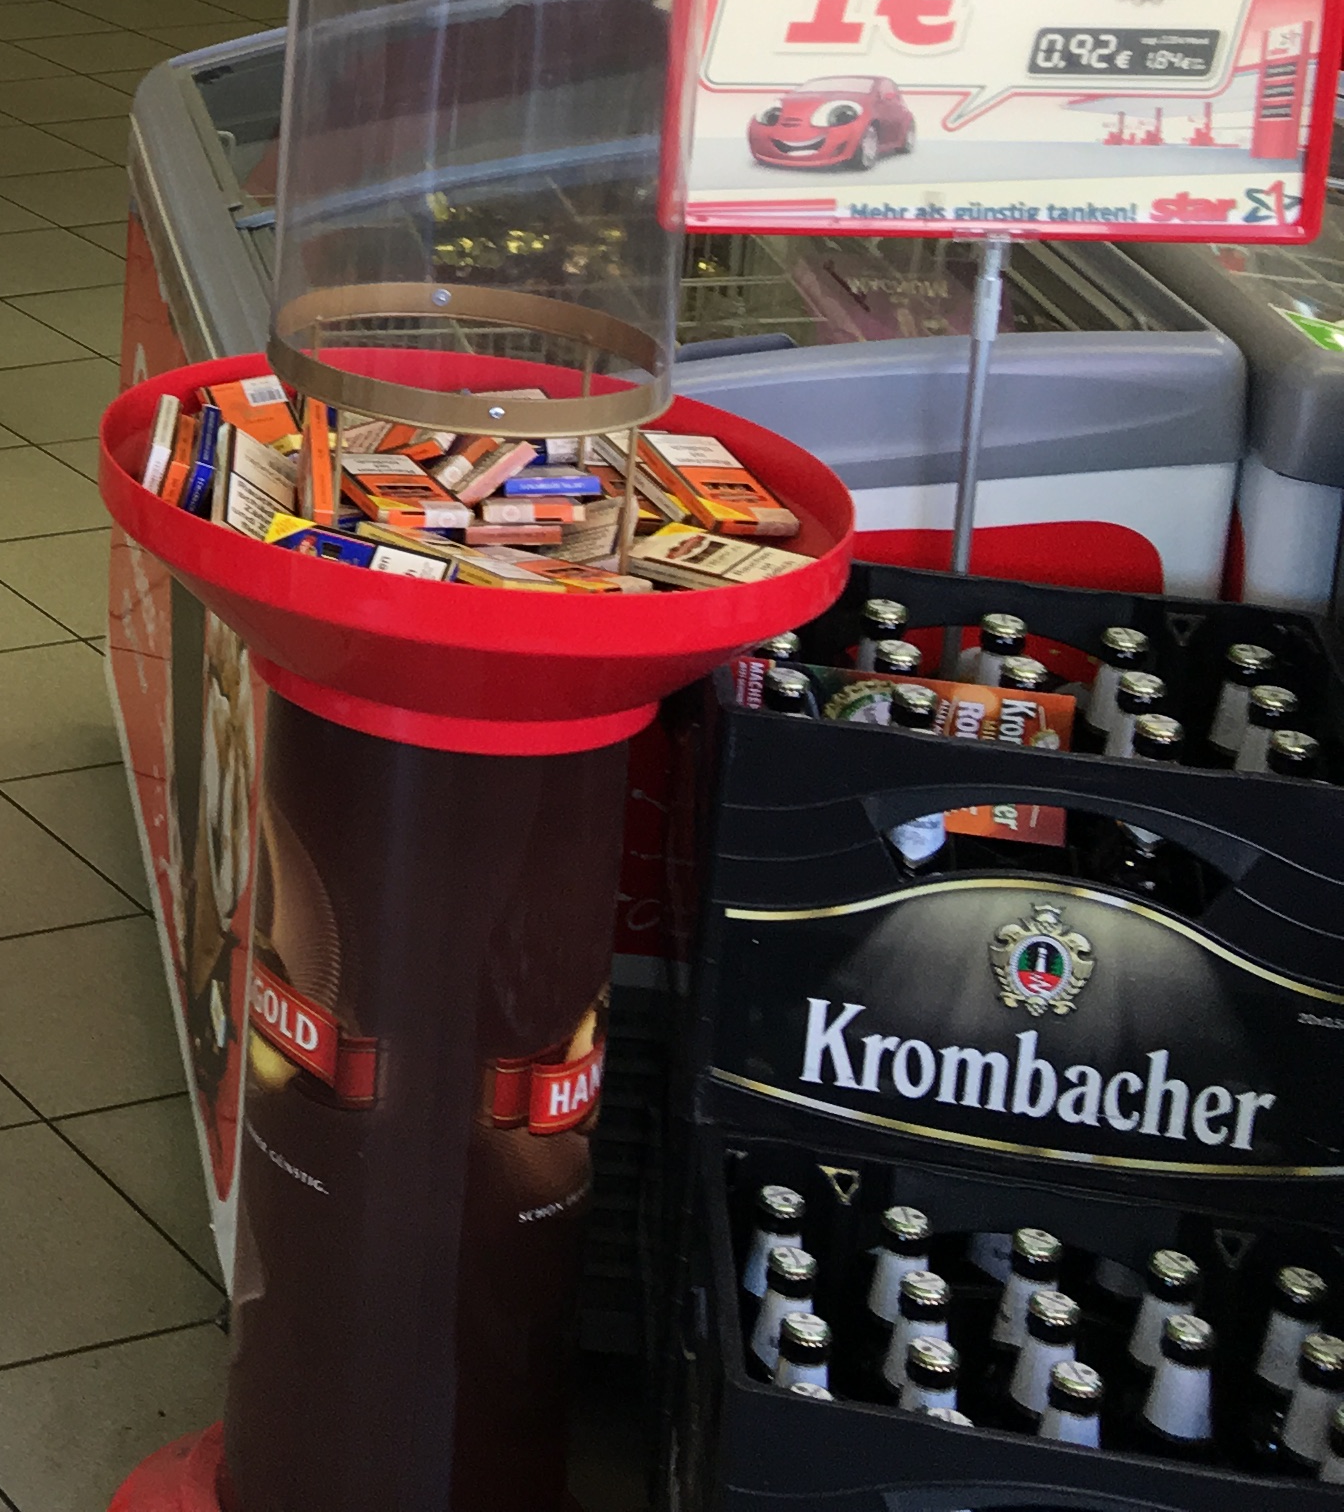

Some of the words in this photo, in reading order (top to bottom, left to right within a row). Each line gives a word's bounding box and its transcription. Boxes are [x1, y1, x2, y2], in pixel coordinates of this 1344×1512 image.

[850, 201, 908, 221] Mehr
[914, 201, 947, 221] als
[953, 200, 1042, 224] günstig
[1046, 200, 1137, 223] tanken!
[1150, 191, 1236, 223] star
[800, 998, 1276, 1151] Krombacher
